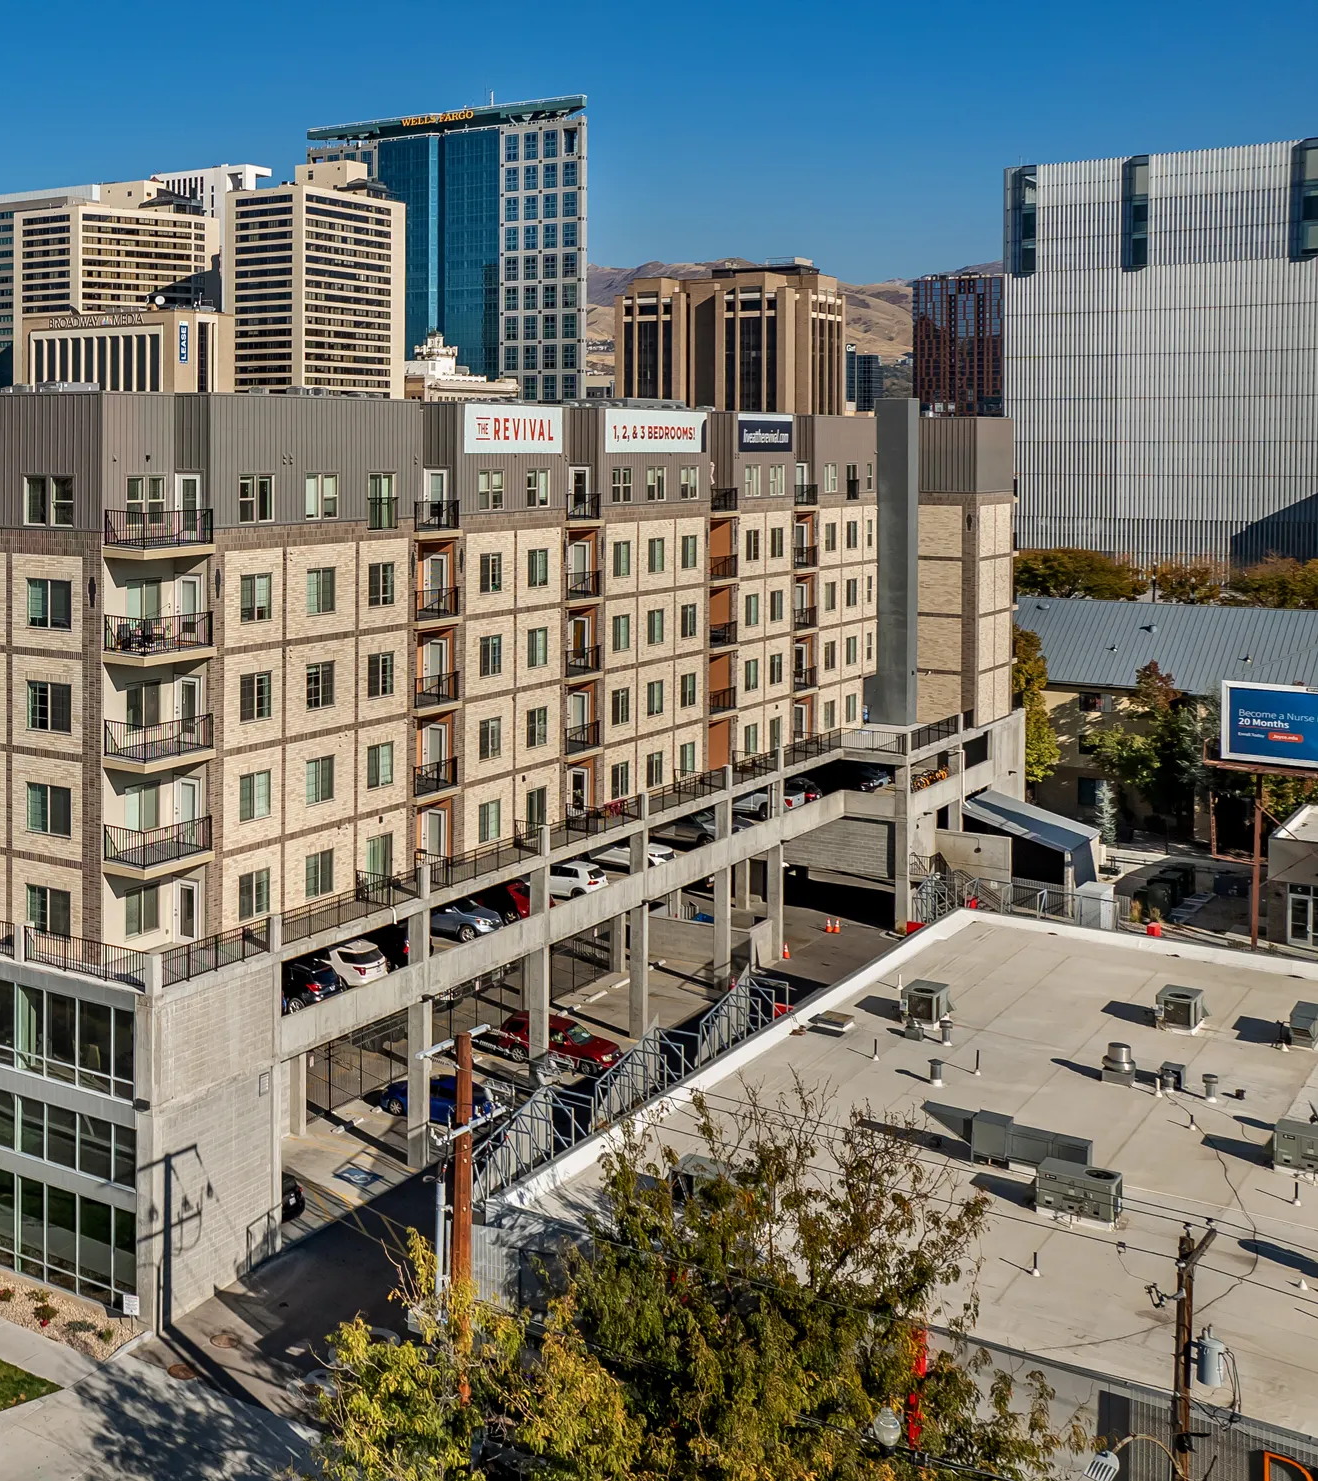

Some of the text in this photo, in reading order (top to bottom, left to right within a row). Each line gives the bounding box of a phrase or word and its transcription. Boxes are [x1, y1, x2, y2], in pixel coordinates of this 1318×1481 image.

[401, 110, 474, 127] WELLS FARGO
[48, 313, 145, 329] BROADWAY MEDIA
[477, 417, 554, 442] THE REVIVAL
[613, 425, 696, 442] 1, 2, & 3 BEDROOMS!
[1238, 708, 1277, 719] Become
[1287, 713, 1315, 722] Nurse
[1238, 717, 1290, 729] 20 Months
